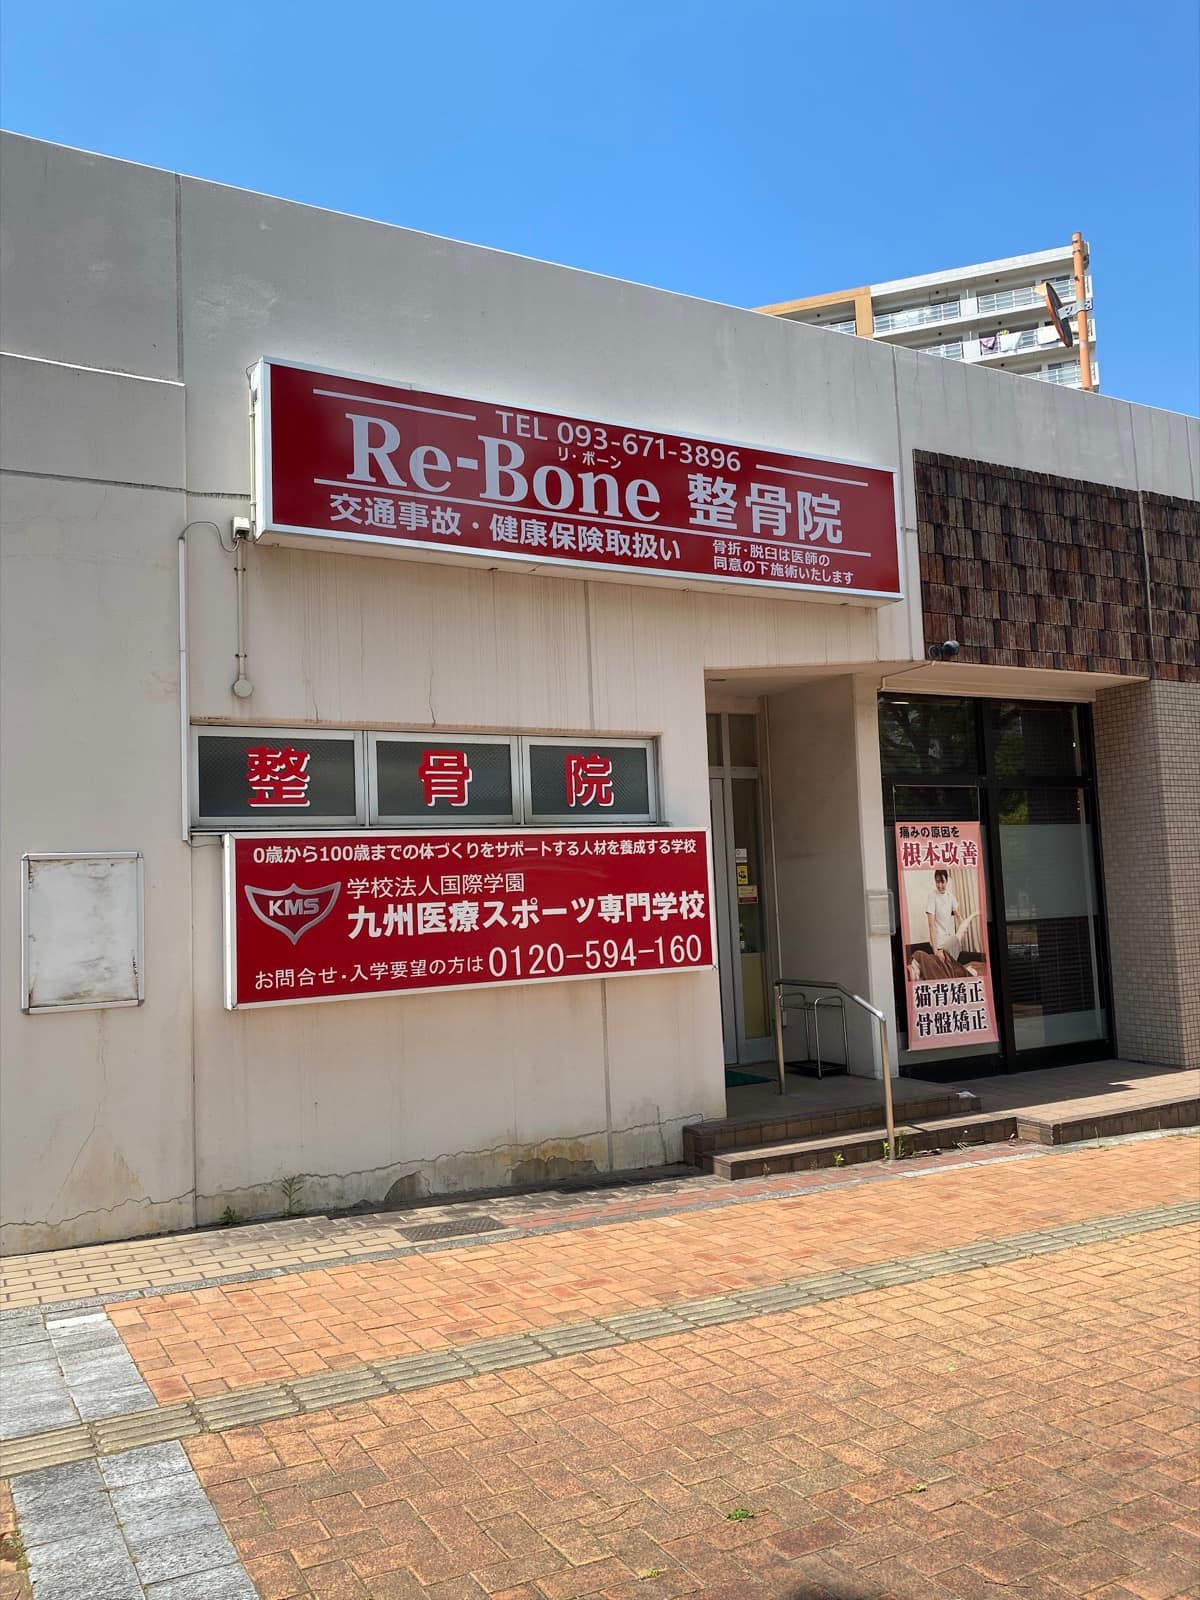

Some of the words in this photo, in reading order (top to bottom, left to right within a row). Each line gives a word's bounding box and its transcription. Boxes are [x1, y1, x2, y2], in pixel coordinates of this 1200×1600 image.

[495, 410, 548, 440] TEL
[557, 422, 741, 472] 093-671-3896
[558, 447, 622, 469] リ・ボーン
[345, 413, 661, 522] Re-Bone
[687, 473, 843, 544] 整骨院
[330, 493, 681, 560] 交通事故・健康保険取扱い
[712, 539, 830, 567] 骨折・脱臼は医師の
[713, 556, 854, 585] 同意の下施術いたします
[899, 826, 960, 839] 痛みの原因を
[253, 839, 697, 863] 0歳から100歳までの体づくりをサポートする人材を養成する学校
[902, 841, 978, 867] 根本改善
[347, 873, 525, 899] 学校法人国際学園
[268, 898, 320, 916] KMS
[348, 890, 706, 939] 九州医療スポーツ専門学校
[255, 956, 484, 990] お問合せ・入学要望の方は
[488, 934, 702, 977] 0120-594-160
[915, 981, 985, 1009] 猫背矯正
[916, 1008, 988, 1037] 骨盤矯正
